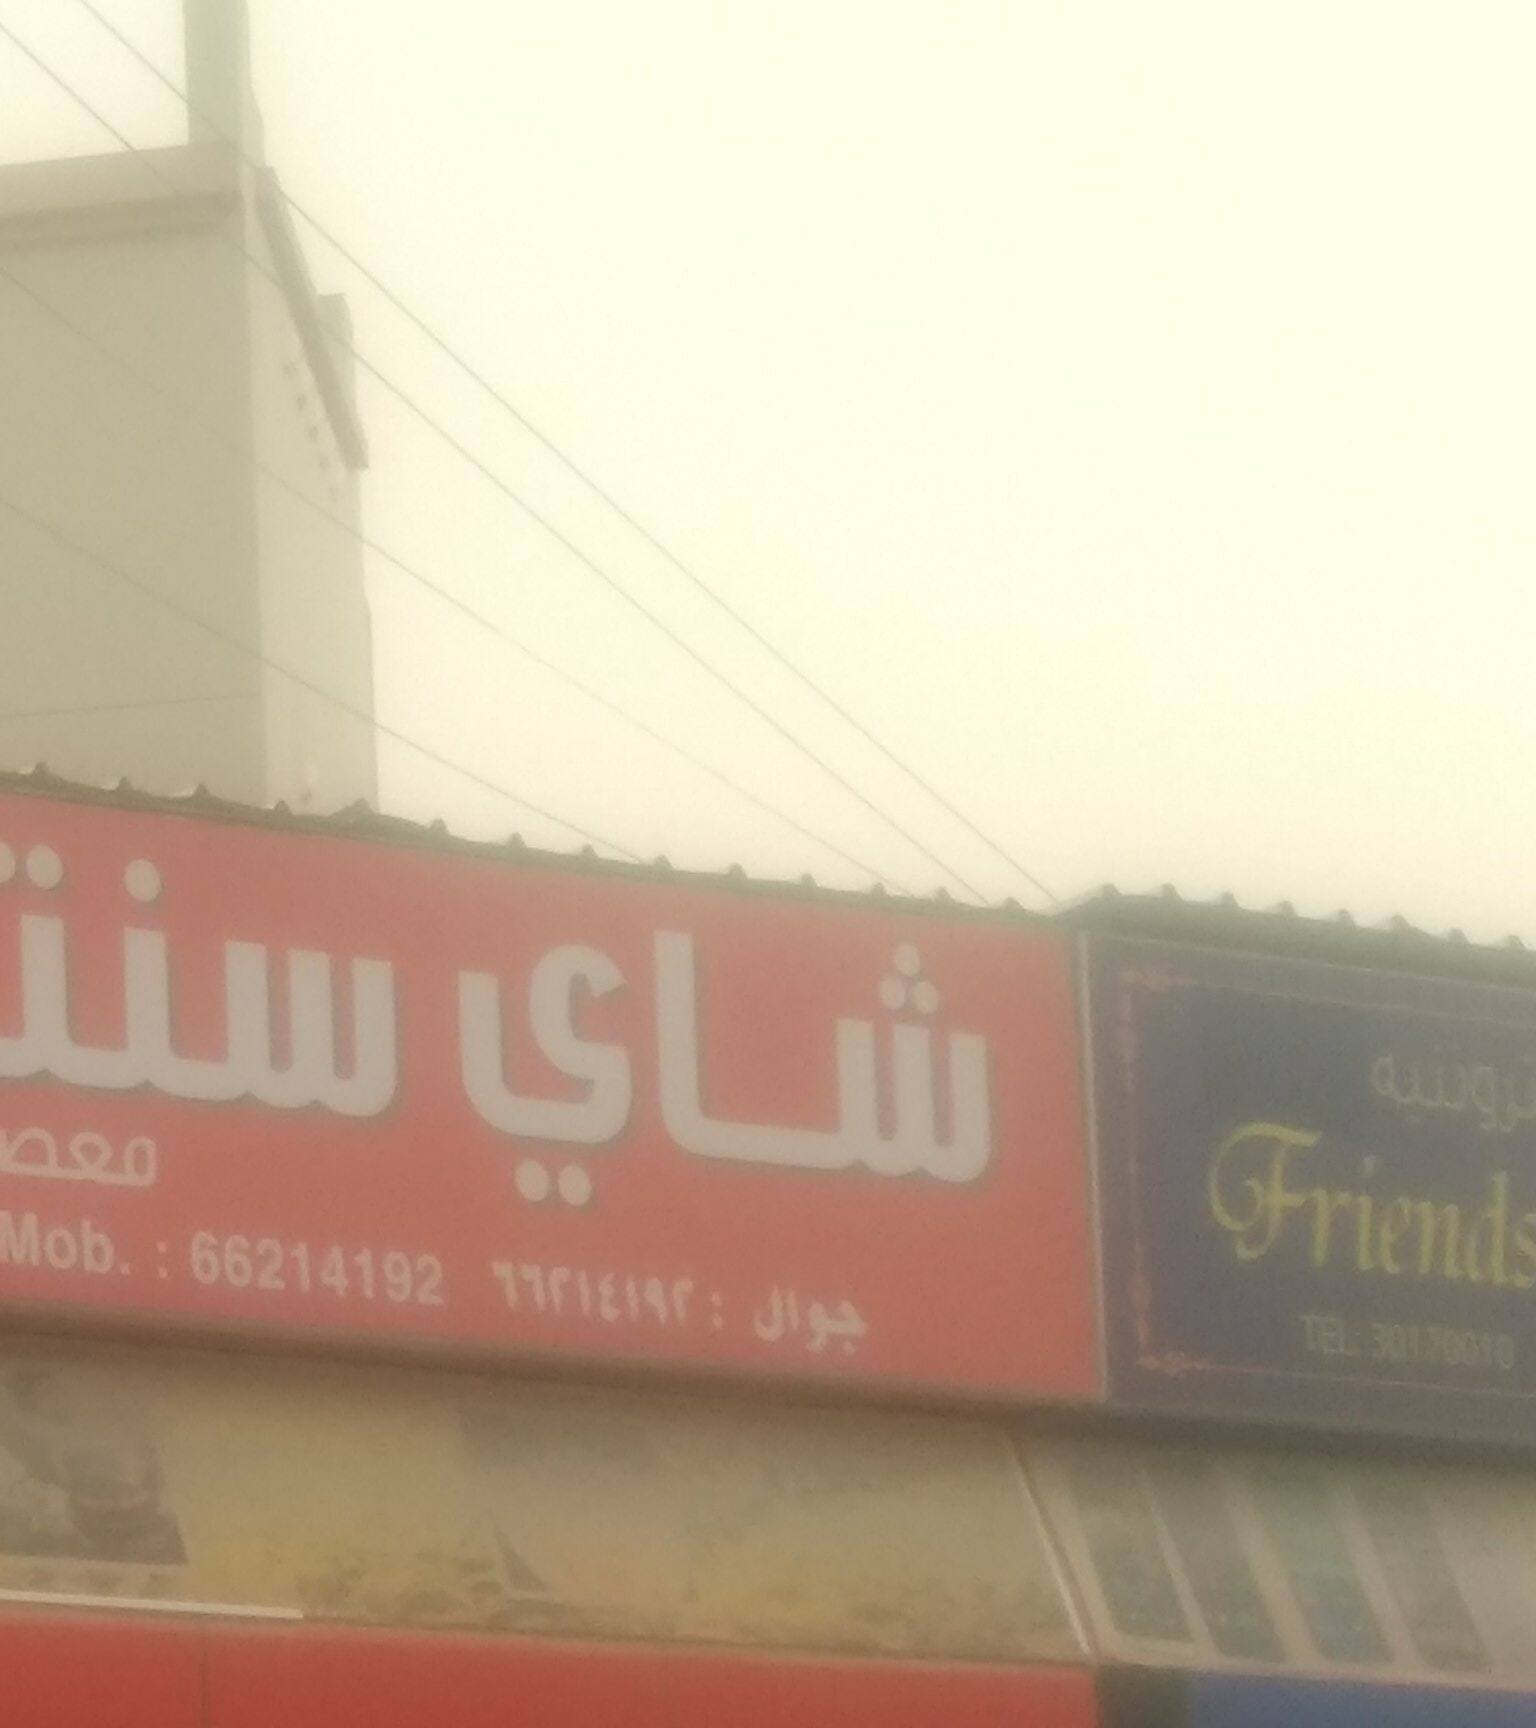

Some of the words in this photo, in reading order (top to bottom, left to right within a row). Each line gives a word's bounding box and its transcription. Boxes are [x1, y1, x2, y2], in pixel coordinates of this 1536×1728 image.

[457, 927, 994, 1207] شاي
[189, 1229, 446, 1308] 66214192
[752, 1283, 870, 1357] جوال
